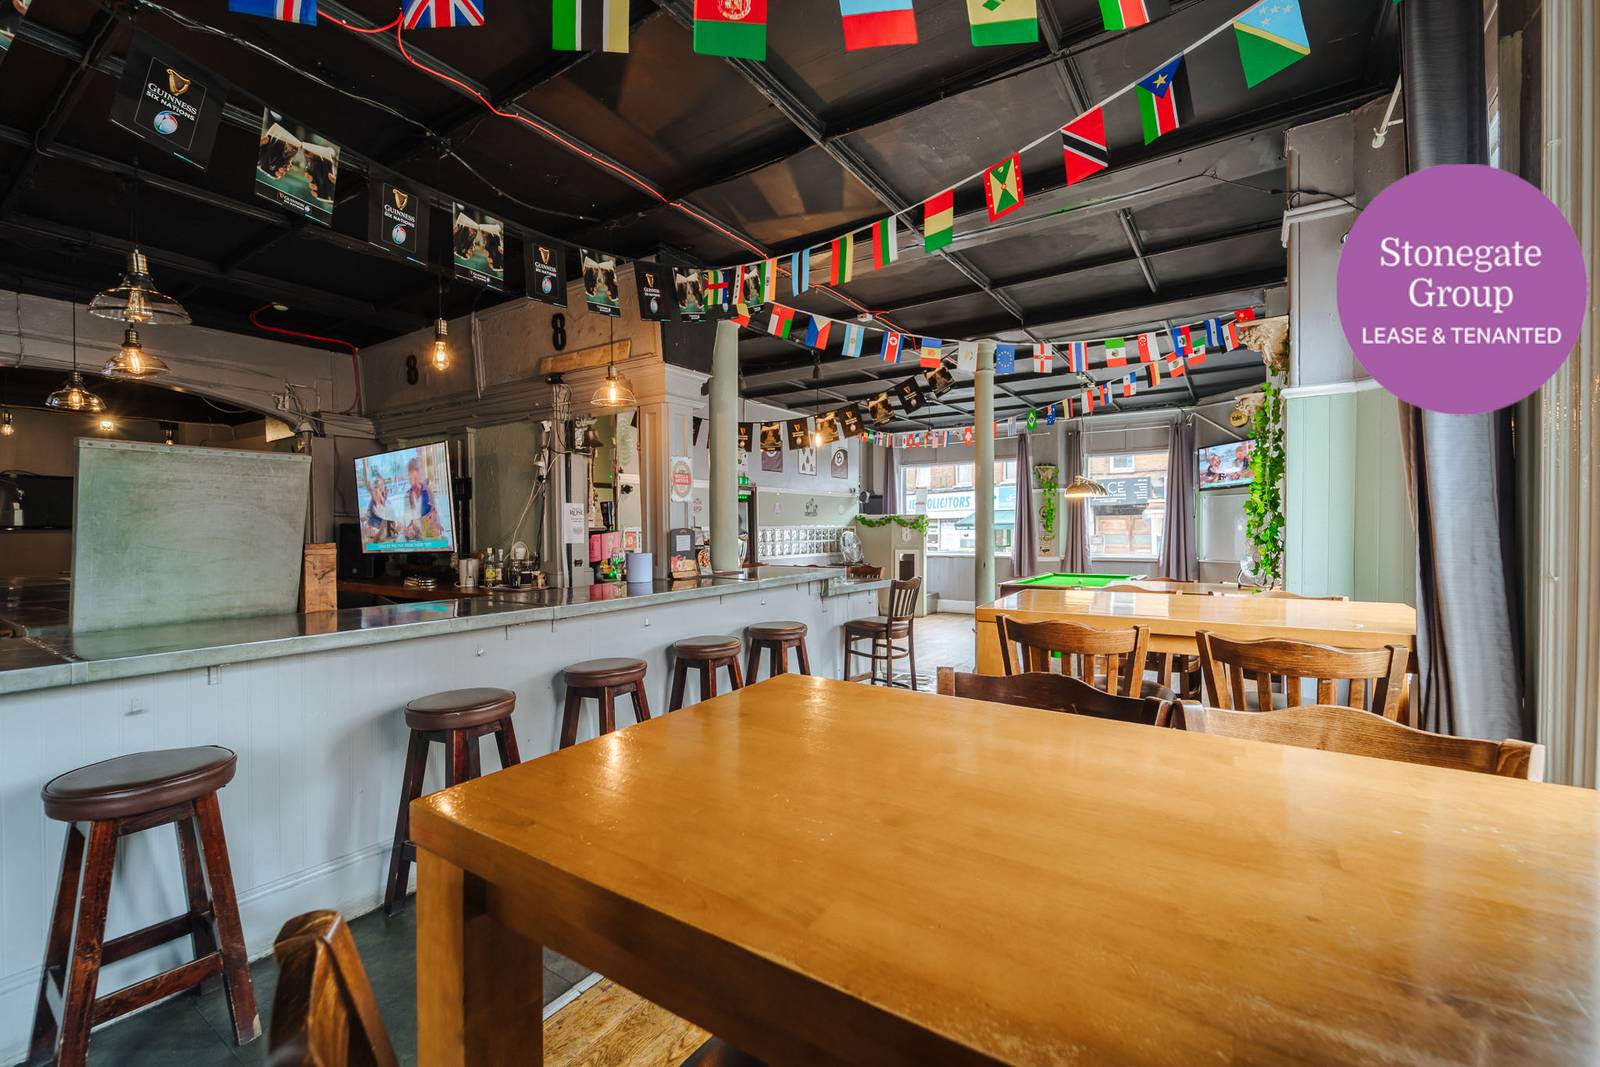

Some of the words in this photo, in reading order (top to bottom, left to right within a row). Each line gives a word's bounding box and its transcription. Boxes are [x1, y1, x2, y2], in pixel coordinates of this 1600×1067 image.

[145, 90, 160, 102] SIX
[160, 98, 196, 121] NATIONS
[147, 82, 198, 115] GUINNESS
[384, 204, 416, 222] GUINNESS
[551, 312, 567, 351] 8
[406, 354, 419, 386] 8
[926, 495, 971, 511] OLICITORS
